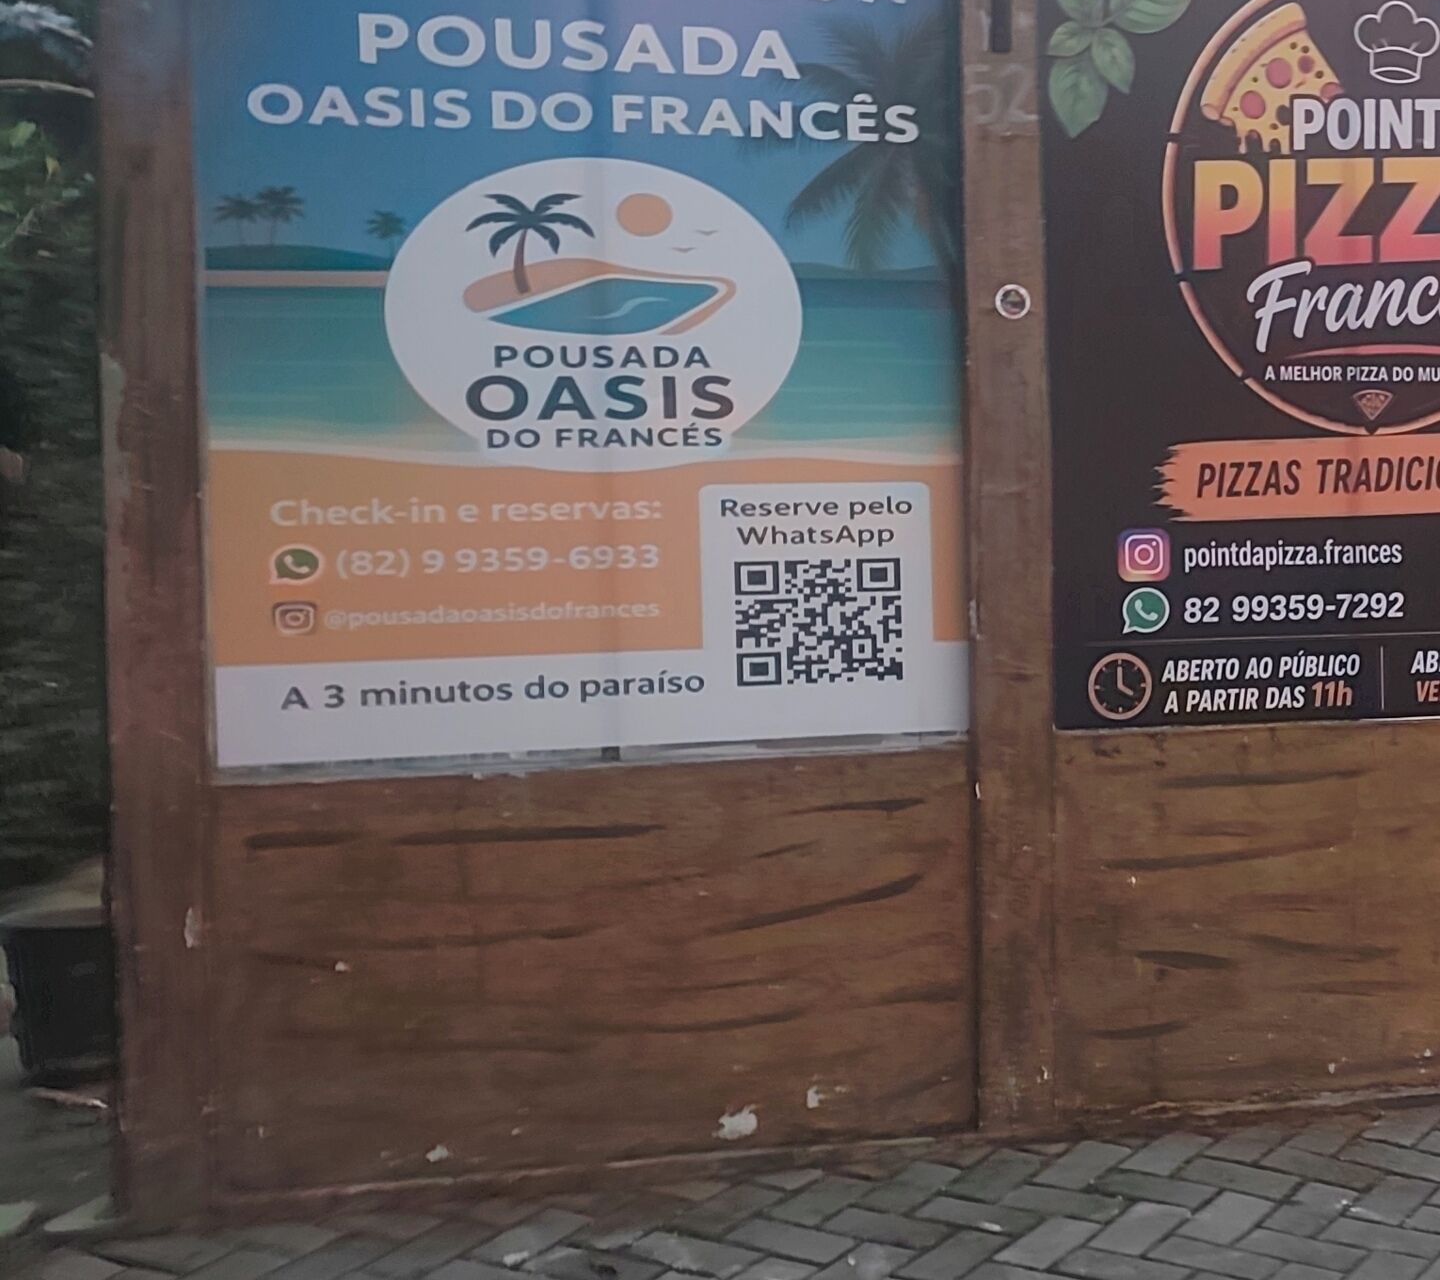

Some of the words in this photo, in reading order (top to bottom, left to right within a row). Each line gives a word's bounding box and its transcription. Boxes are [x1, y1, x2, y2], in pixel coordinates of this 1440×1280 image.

[357, 12, 800, 80] POUSADA
[247, 83, 472, 129] OASIS
[491, 91, 593, 133] DO
[613, 93, 920, 144] FRANCÊS
[494, 345, 711, 369] POUSADA
[1264, 364, 1278, 382] A
[1279, 365, 1343, 382] MELHOR
[1346, 365, 1388, 382] PIZZA
[1393, 365, 1414, 382] DO
[465, 375, 734, 421] OASIS
[487, 428, 540, 449] DO
[1197, 459, 1301, 499] PIZZAS
[269, 497, 446, 527] Check-in
[456, 501, 479, 523] e
[491, 499, 662, 522] reservas:
[720, 496, 840, 517] Reserve
[848, 495, 913, 521] pelo
[736, 523, 895, 549] WhatsApp
[335, 549, 409, 579] (82)
[422, 549, 445, 574] 9
[455, 544, 660, 572] 9359-6933
[1183, 538, 1402, 572] pointdapizza.frances
[1183, 596, 1219, 624] 82
[1232, 592, 1404, 621] 99359-7292
[1162, 656, 1241, 683] ABERTO
[1246, 655, 1274, 679] AO
[1278, 649, 1361, 678] PÚBLICO
[281, 686, 309, 711] A
[324, 684, 345, 709] 3
[360, 679, 513, 707] minutos
[524, 675, 570, 701] do
[580, 668, 706, 701] paraíso
[1163, 690, 1179, 714] A
[1181, 687, 1261, 713] PARTIR
[1265, 686, 1305, 710] DAS
[1311, 681, 1353, 708] 11h
